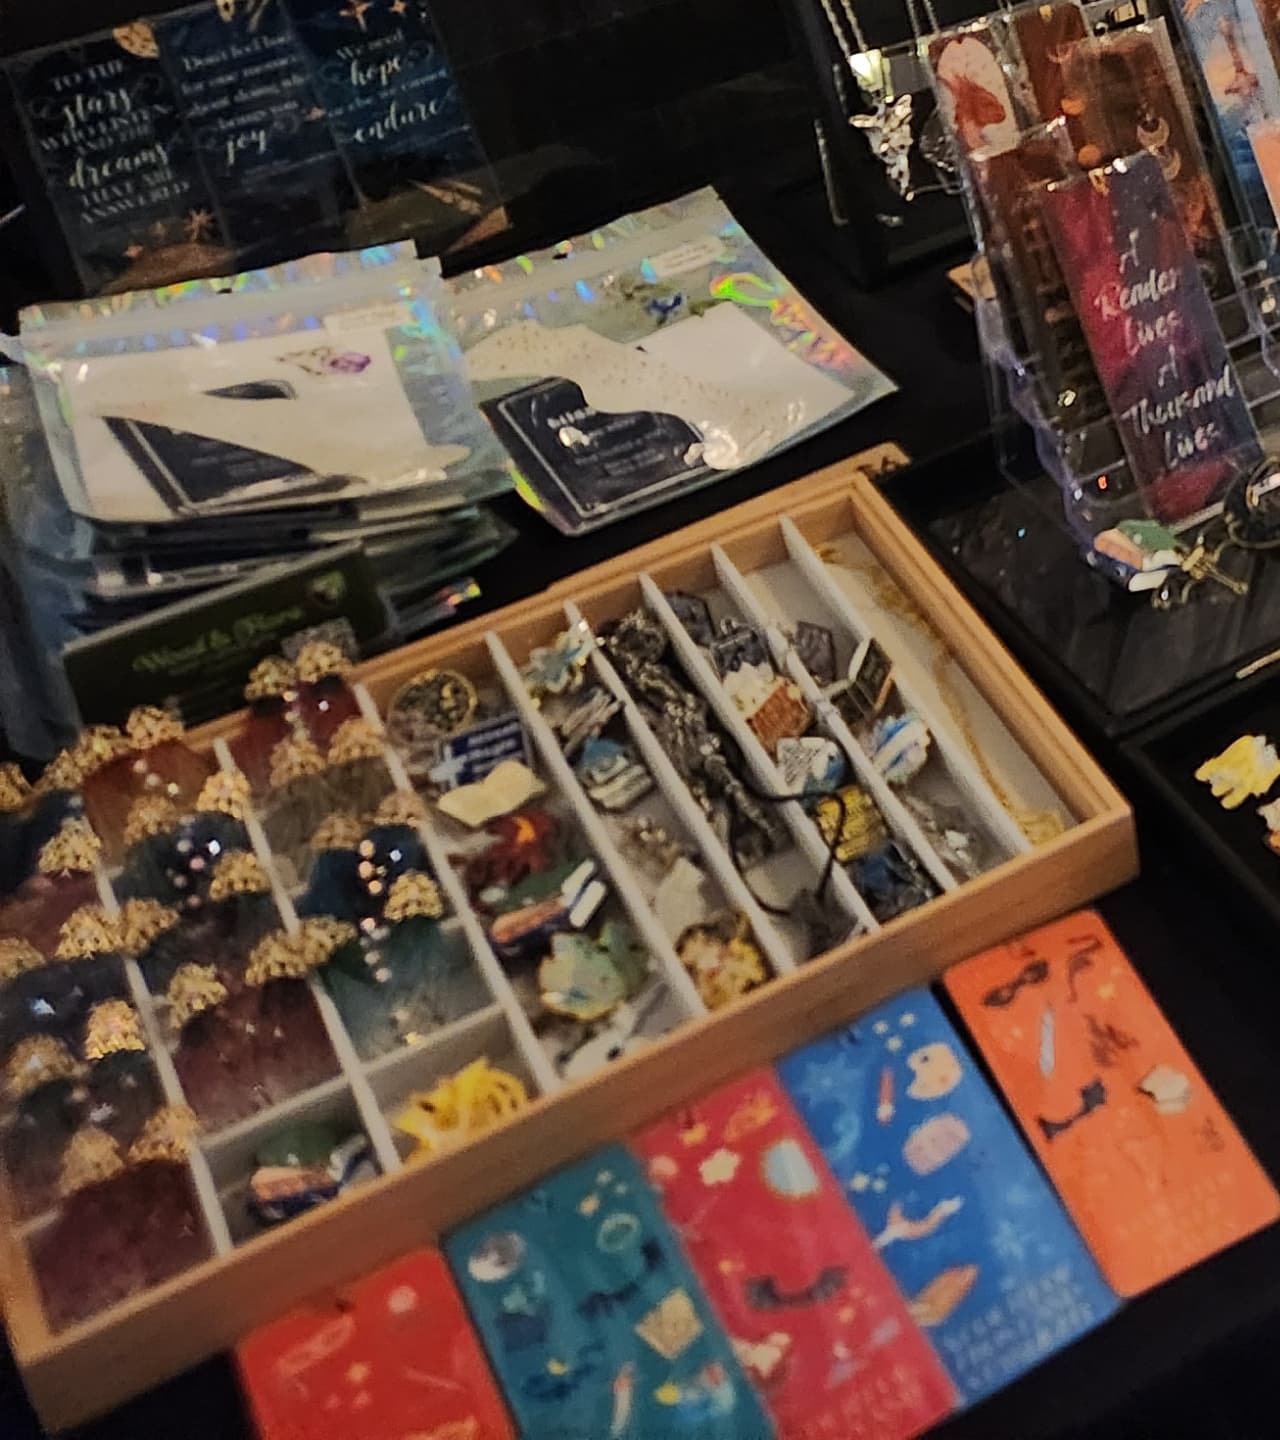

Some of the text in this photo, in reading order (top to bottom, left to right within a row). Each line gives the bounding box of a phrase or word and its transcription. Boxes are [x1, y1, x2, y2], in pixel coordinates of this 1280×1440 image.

[50, 72, 83, 93] TO
[349, 53, 404, 88] hope
[352, 97, 441, 145] endure
[67, 141, 170, 191] dreams
[224, 128, 269, 173] joy
[1093, 265, 1183, 324] Reader
[1123, 309, 1184, 358] Lives
[1119, 362, 1236, 437] Thousand
[1162, 421, 1224, 473] Lives
